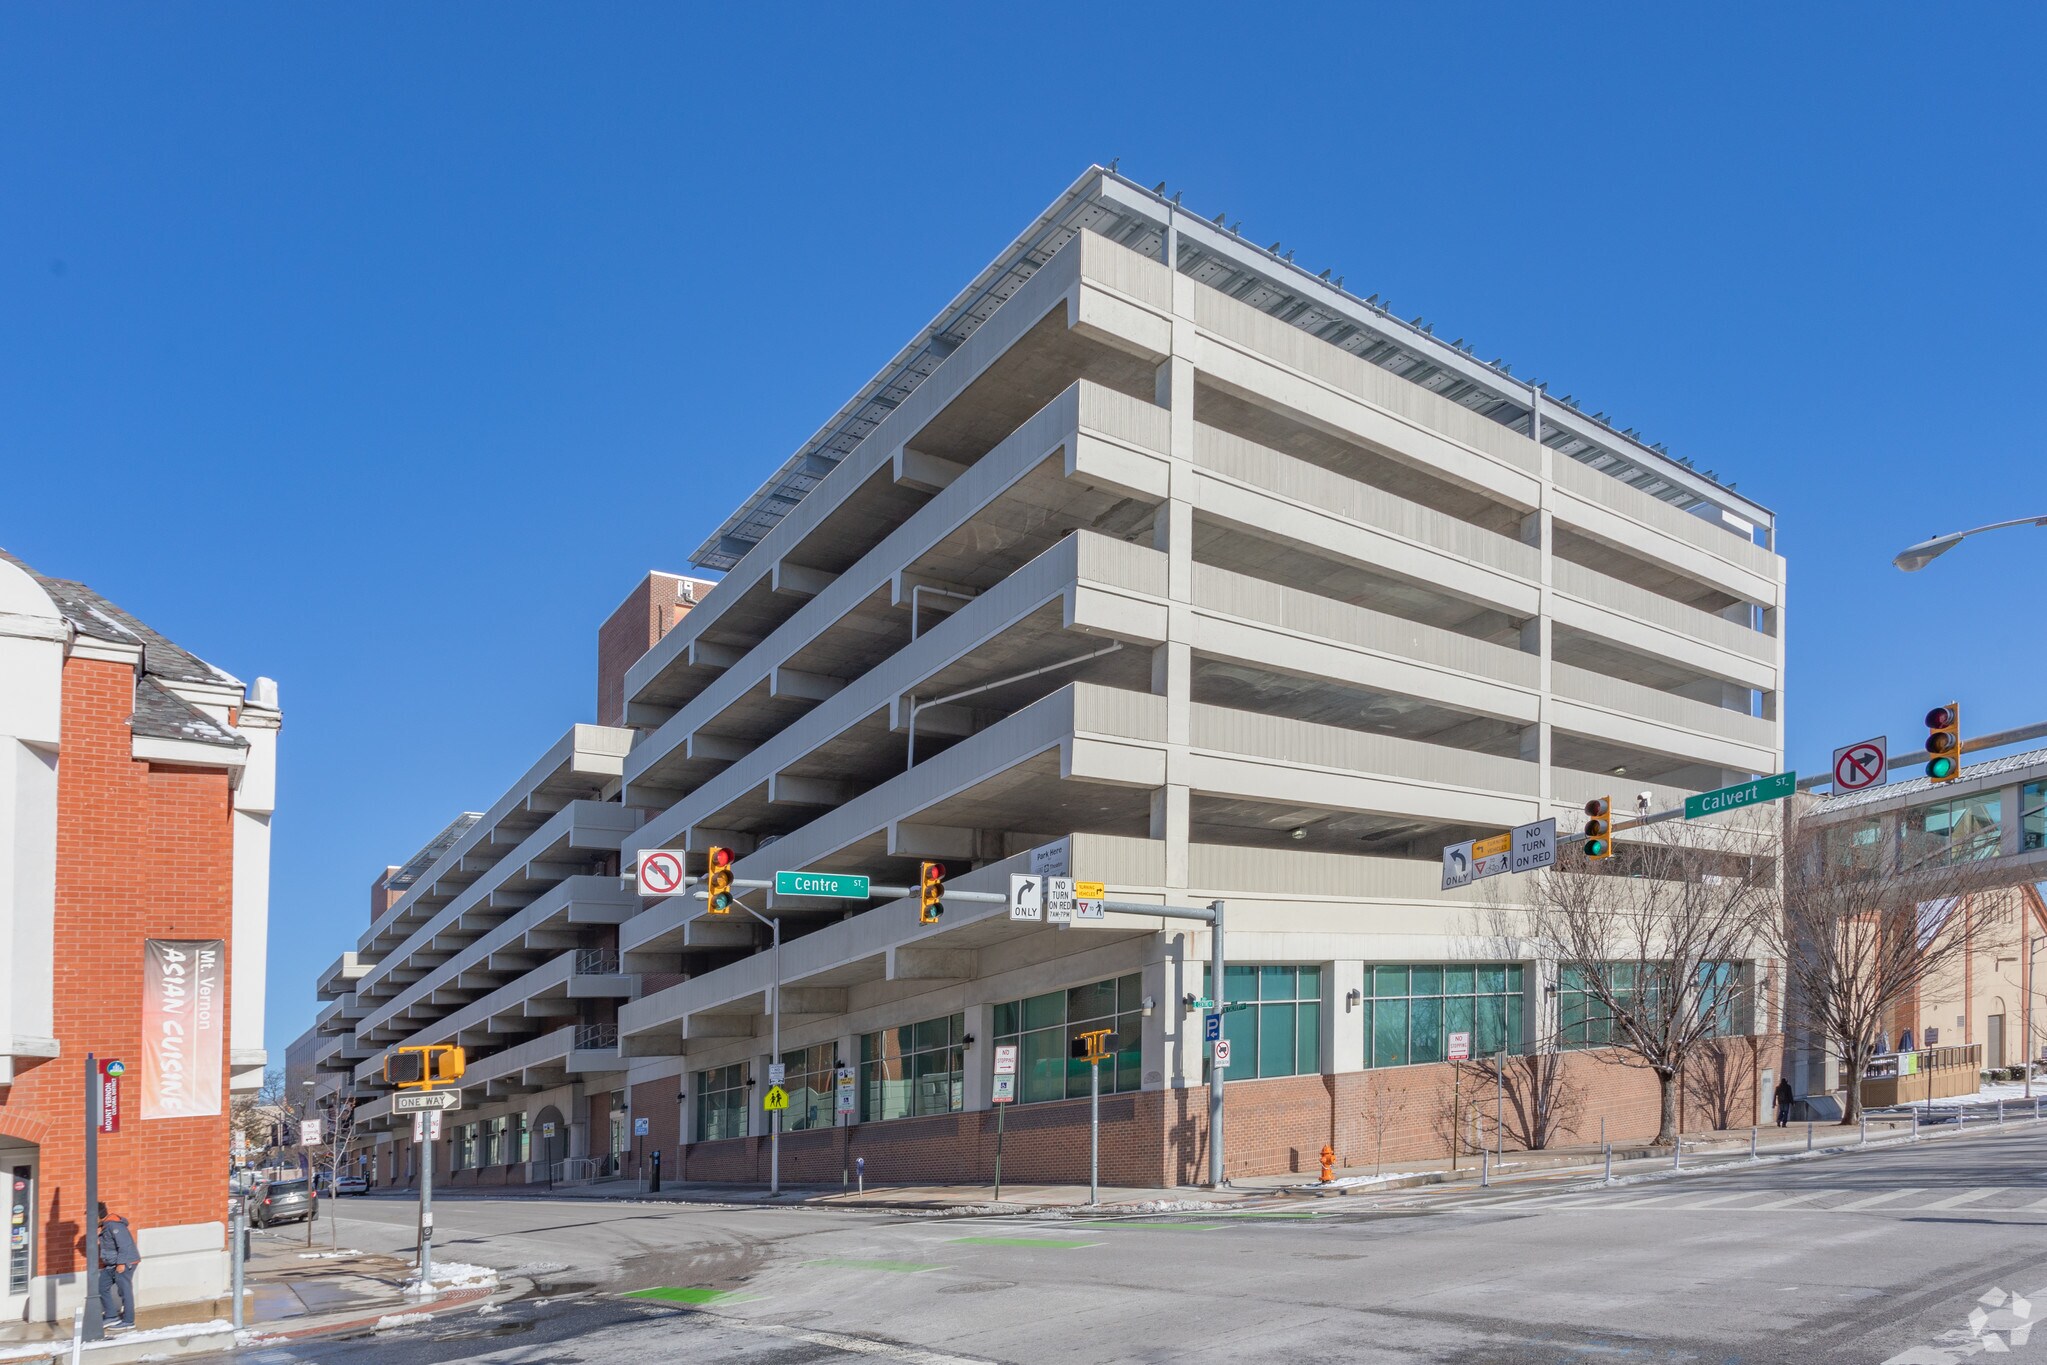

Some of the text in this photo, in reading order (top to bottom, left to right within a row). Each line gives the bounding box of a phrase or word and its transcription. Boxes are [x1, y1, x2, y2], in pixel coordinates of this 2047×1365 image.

[1702, 785, 1757, 811] Calvert
[1526, 827, 1541, 839] NO
[1521, 839, 1546, 853] TURN
[1037, 847, 1063, 861] Park Here
[1516, 851, 1551, 868] ON RED
[795, 877, 862, 892] Centre ST
[1055, 881, 1066, 890] NO
[1446, 873, 1469, 886] ONLY
[1052, 891, 1069, 900] TURN
[1015, 907, 1037, 916] ONLY
[1049, 901, 1071, 910] ON RED
[199, 950, 216, 1030] Mt. Vernon
[159, 947, 187, 1109] ASIAN CUISINE
[401, 1096, 445, 1107] ONE WAY
